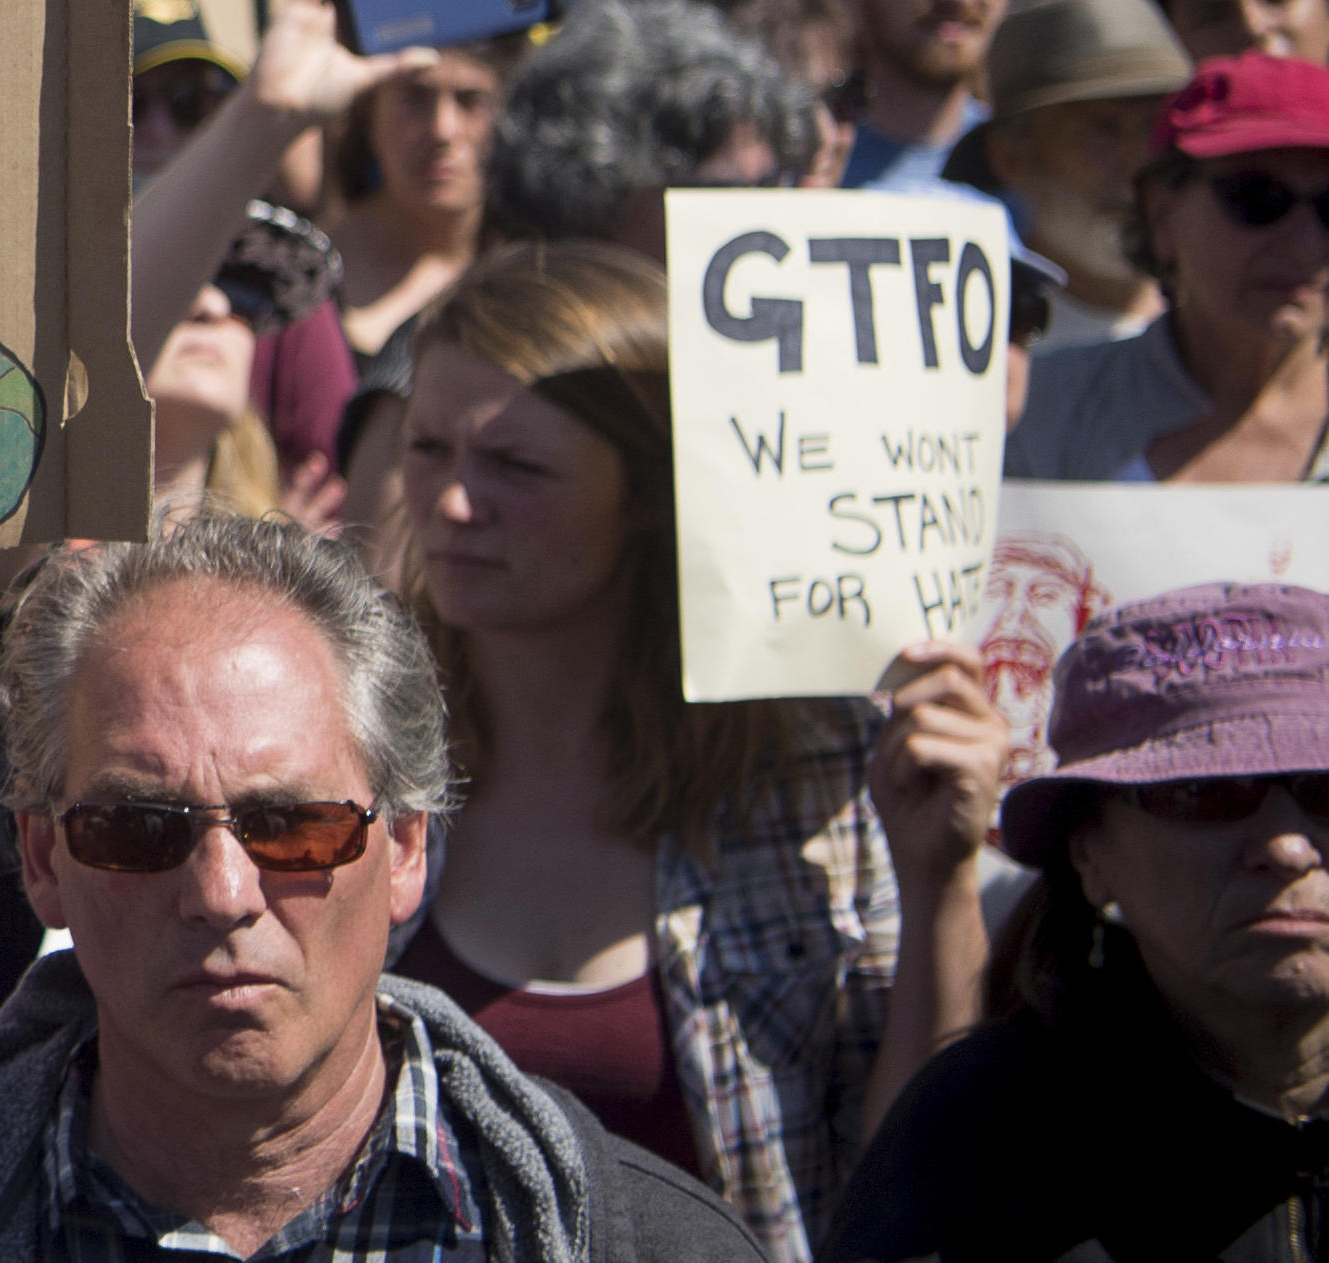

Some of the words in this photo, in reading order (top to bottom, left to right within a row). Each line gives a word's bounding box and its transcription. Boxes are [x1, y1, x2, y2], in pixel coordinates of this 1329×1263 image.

[702, 231, 996, 375] GTFO
[730, 410, 835, 477] WE
[881, 431, 981, 477] WONT
[827, 488, 987, 556] STAND
[768, 572, 873, 629] FOR
